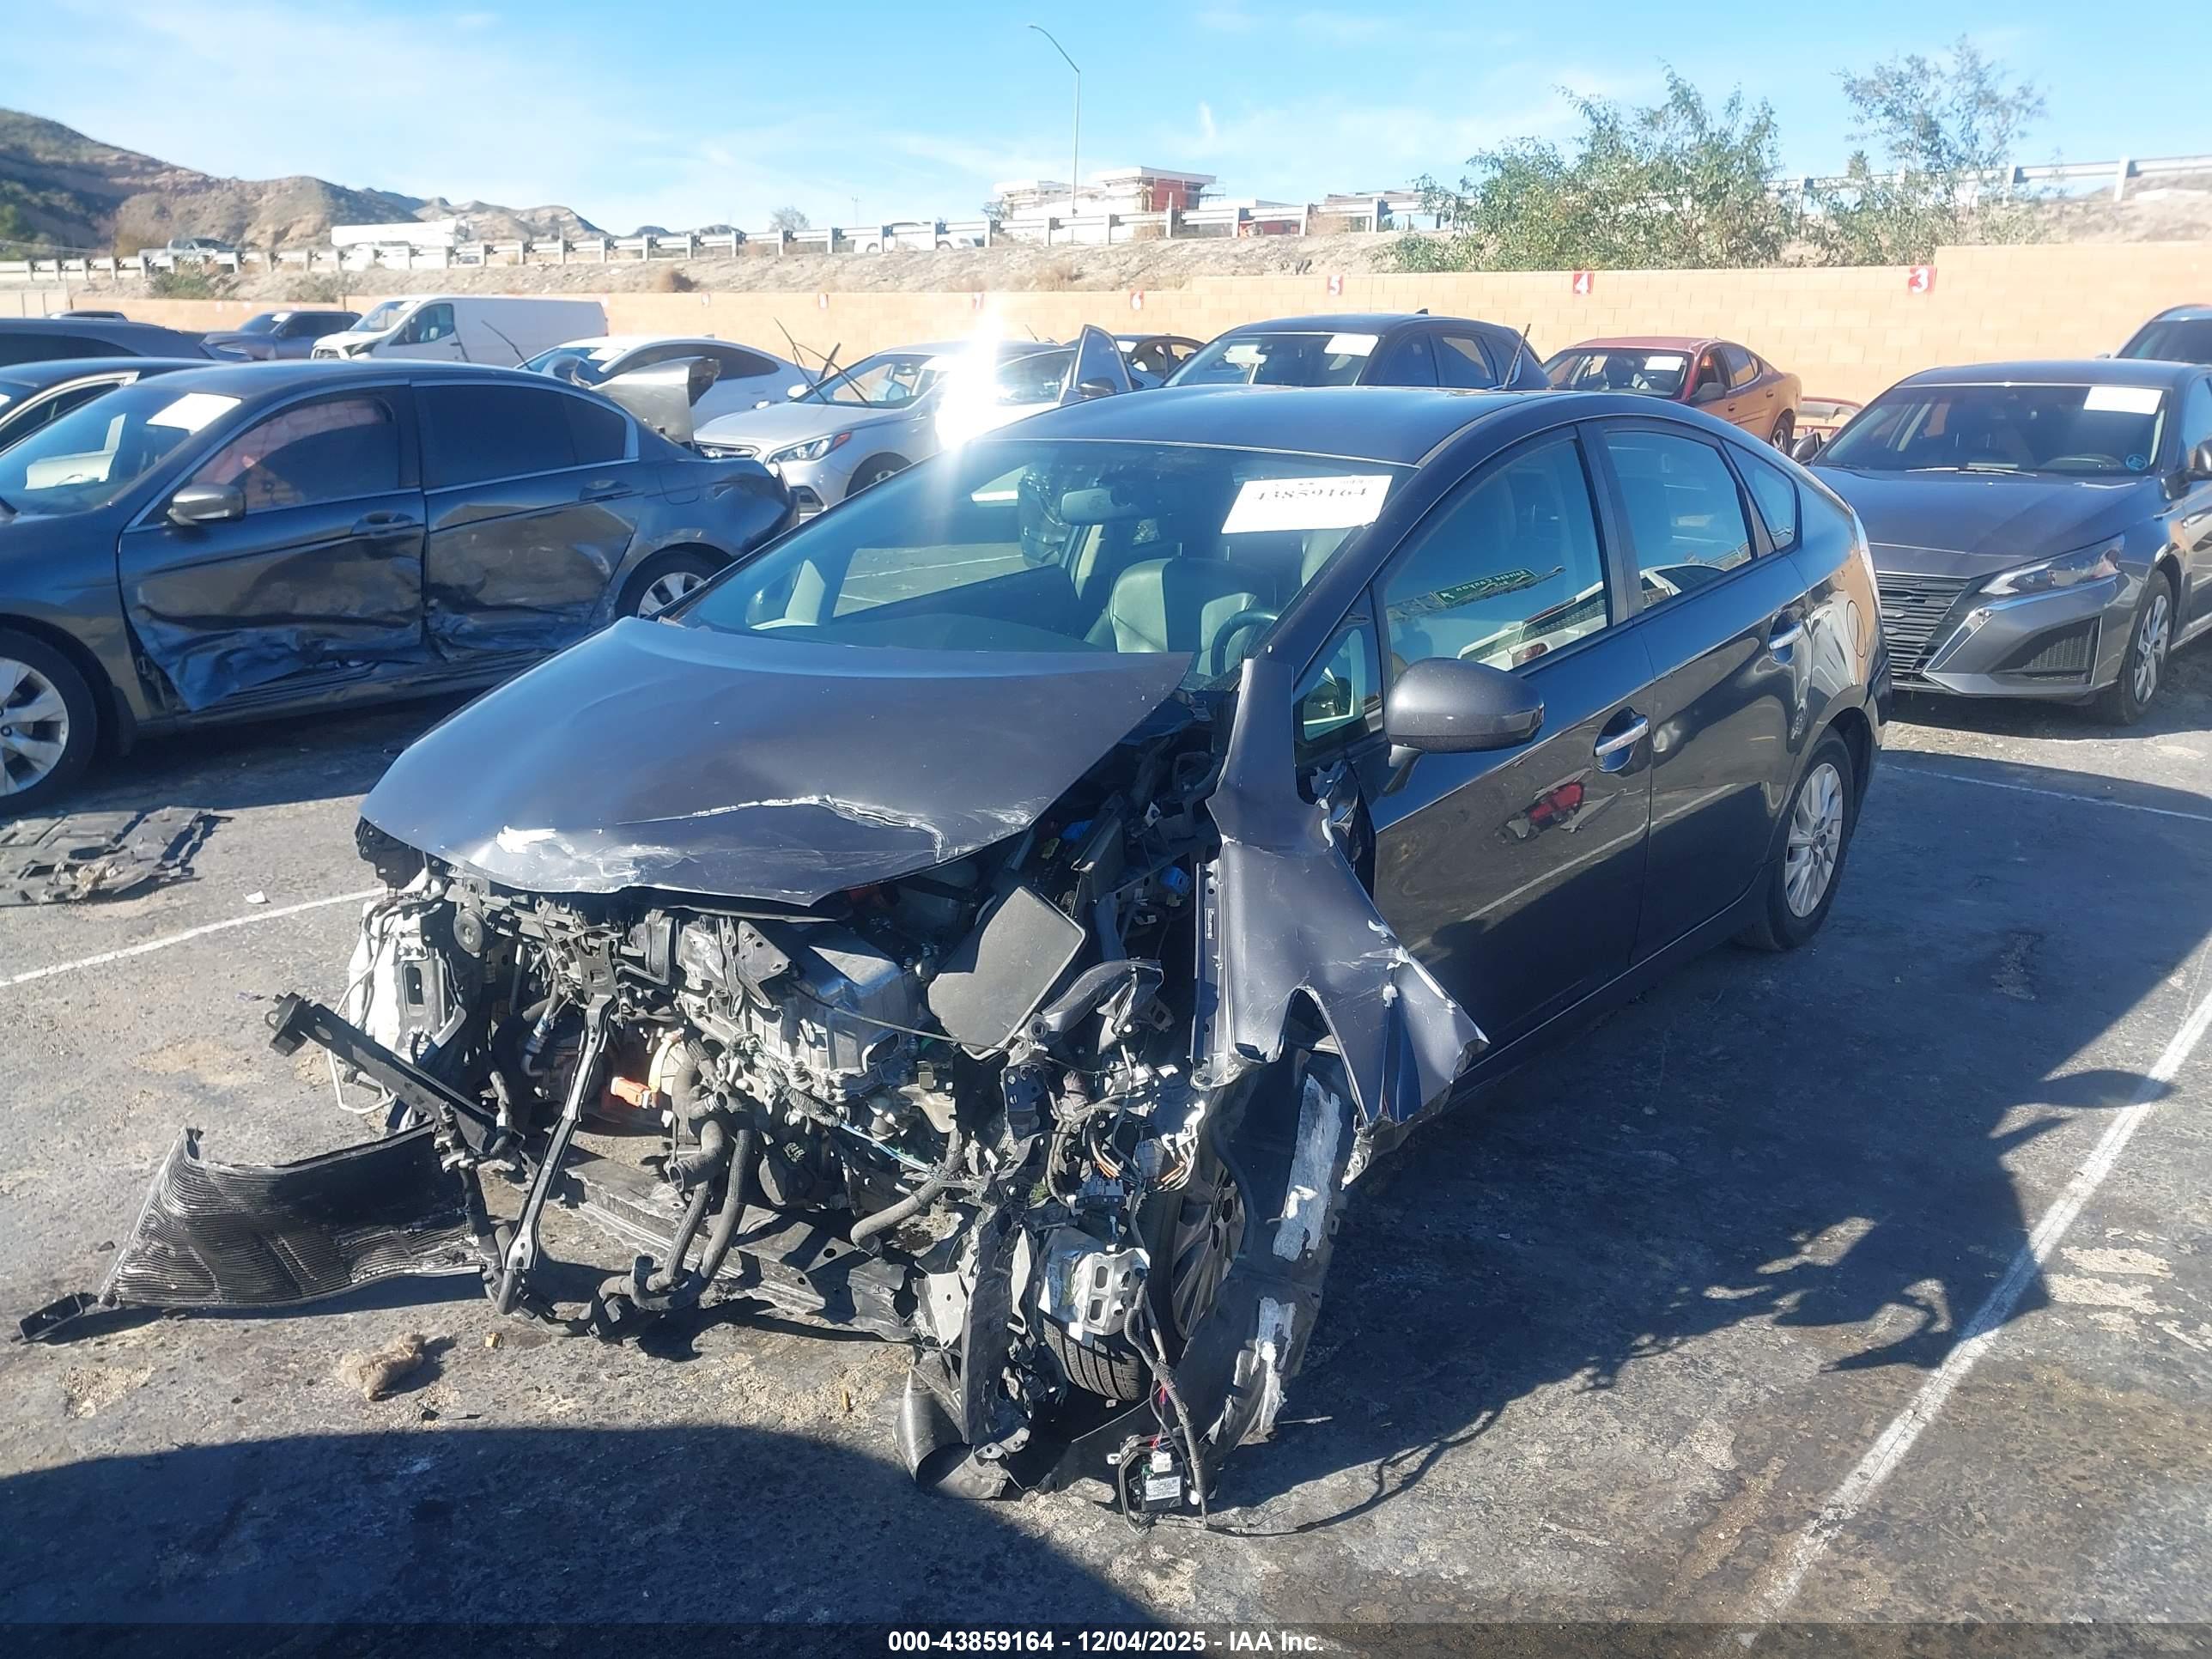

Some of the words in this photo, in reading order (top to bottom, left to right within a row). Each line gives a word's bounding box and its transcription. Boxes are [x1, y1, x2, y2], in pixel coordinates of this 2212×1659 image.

[1328, 274, 1340, 296] 5
[1575, 272, 1589, 295] 4
[1911, 268, 1929, 294] 3
[1132, 290, 1141, 311] 6
